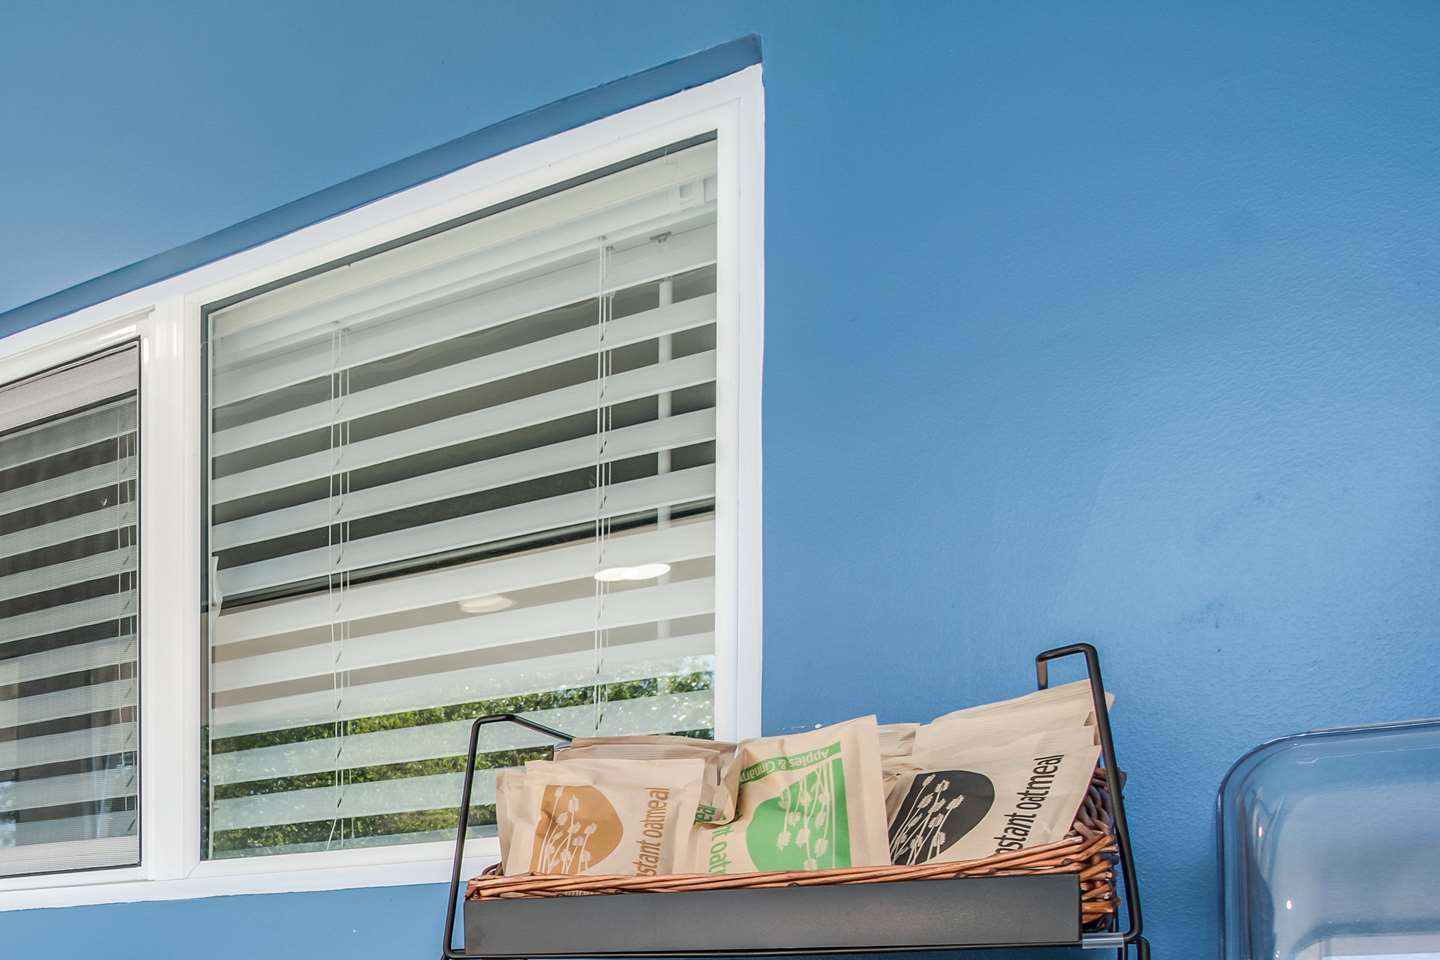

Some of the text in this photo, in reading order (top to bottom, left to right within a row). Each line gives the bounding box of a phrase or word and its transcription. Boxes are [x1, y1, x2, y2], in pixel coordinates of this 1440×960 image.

[631, 787, 670, 877] stant oatmeal
[993, 754, 1065, 853] stant oatmeal
